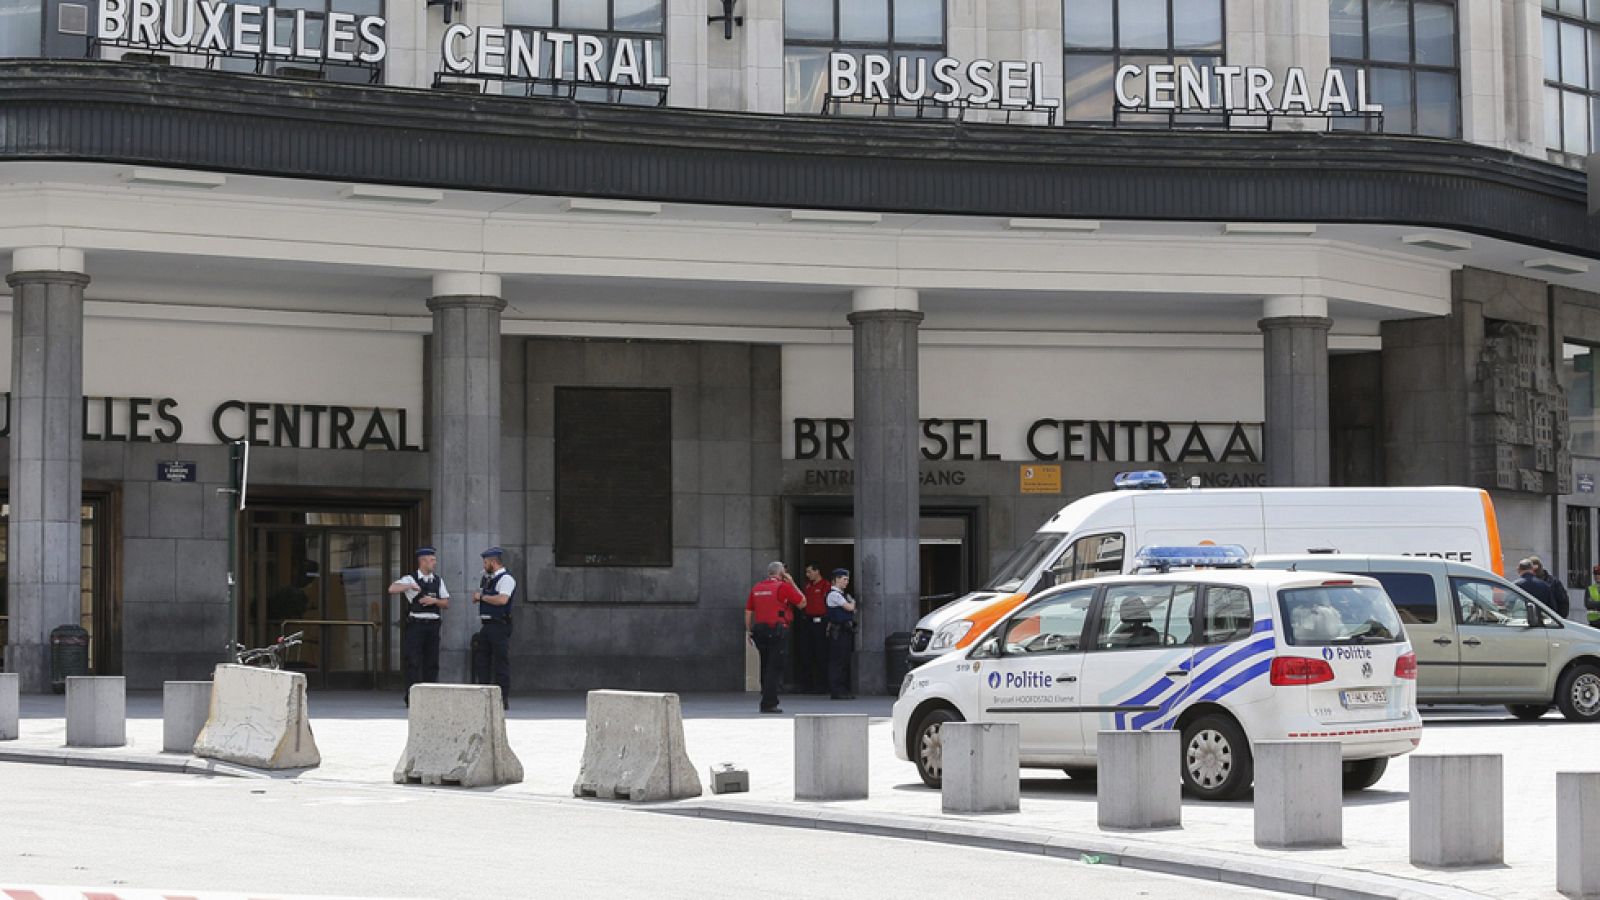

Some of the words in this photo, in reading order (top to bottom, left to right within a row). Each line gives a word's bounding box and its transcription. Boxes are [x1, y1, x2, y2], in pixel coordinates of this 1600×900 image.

[97, 0, 387, 63] BRUXELLES
[443, 24, 670, 87] CENTRAL
[830, 52, 1059, 107] BRUSSEL
[1115, 64, 1384, 112] CENTRAAL
[212, 400, 423, 451] CENTRAL
[795, 417, 1000, 461] BRSEL
[1026, 418, 1265, 463] CENTRAA
[1337, 646, 1372, 659] Politie
[1006, 671, 1053, 689] Politie
